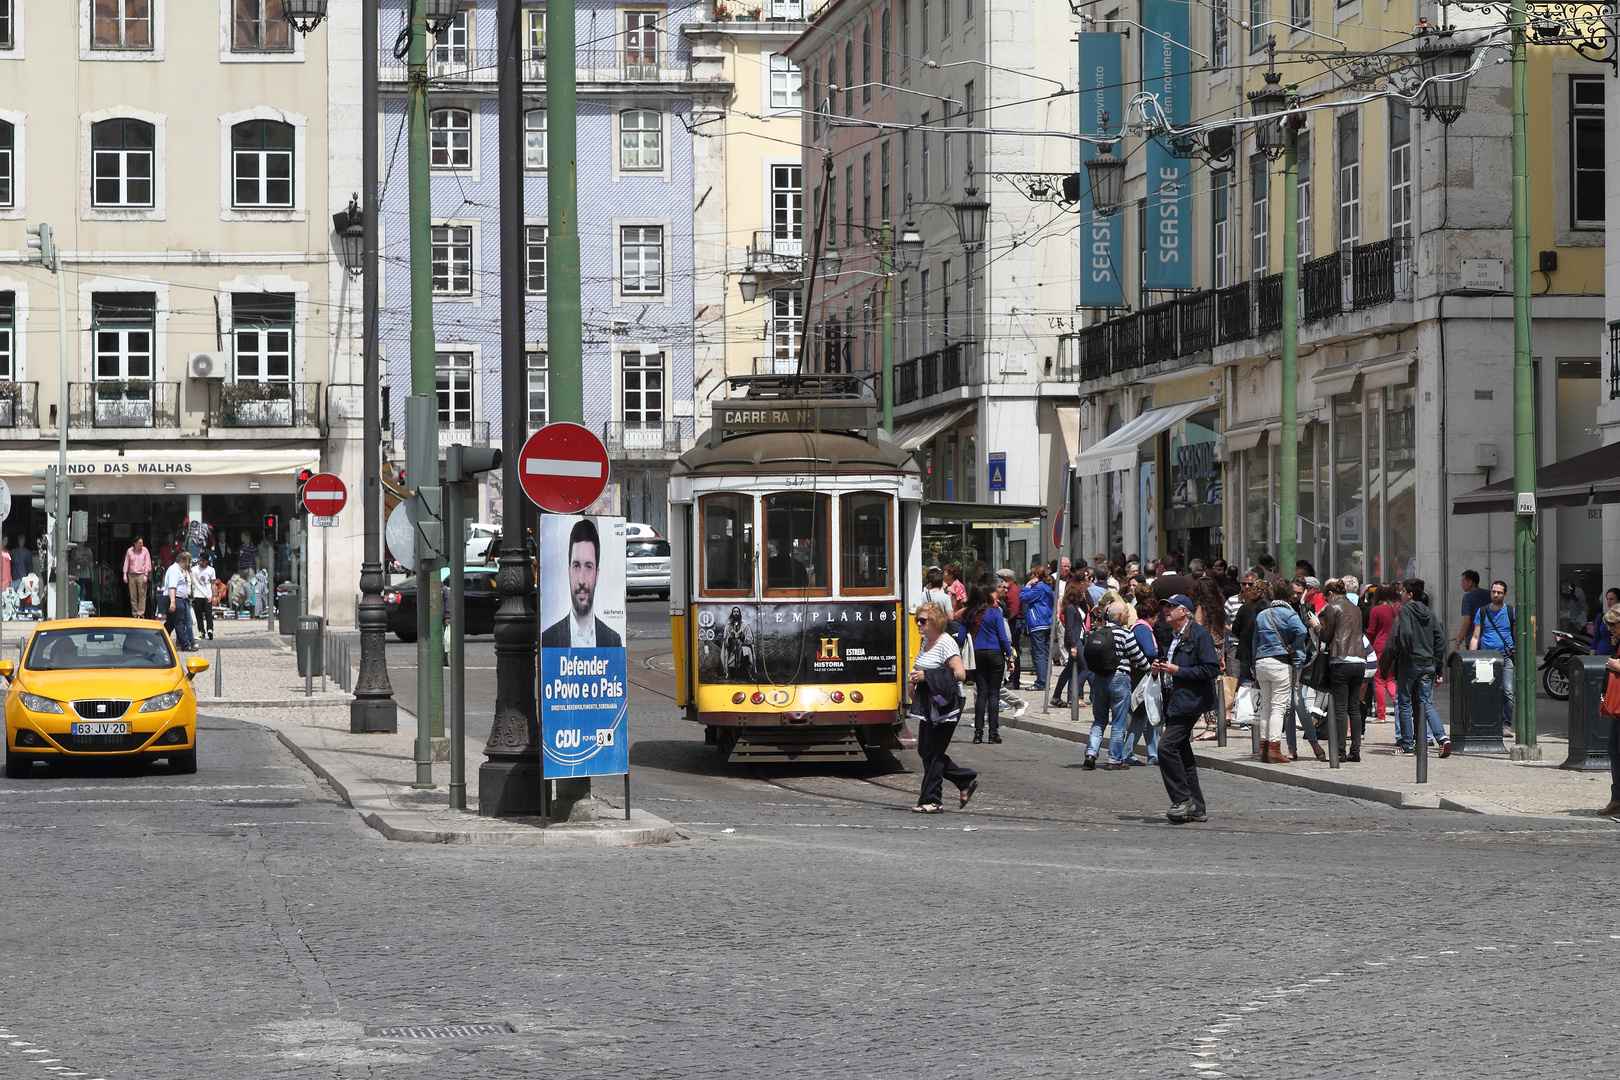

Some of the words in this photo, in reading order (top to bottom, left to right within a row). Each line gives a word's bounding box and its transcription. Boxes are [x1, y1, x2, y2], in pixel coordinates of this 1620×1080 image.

[1162, 31, 1172, 93] movimento
[1160, 167, 1179, 263] SEASIDE
[1092, 209, 1110, 282] SEASI
[725, 411, 790, 424] CARREIRA
[48, 464, 96, 473] MNDO
[104, 464, 129, 472] DAS
[138, 464, 192, 472] MALHAS
[1177, 441, 1217, 482] SEASIDE
[785, 477, 804, 486] 547
[1588, 509, 1602, 518] BET
[758, 609, 896, 623] TEMPLÁRIOS
[820, 637, 840, 658] H
[560, 655, 609, 676] Defender
[546, 684, 552, 700] o
[554, 679, 580, 699] Povo
[582, 682, 589, 698] e
[591, 682, 598, 698] o
[600, 676, 622, 698] País
[556, 729, 580, 748] CDU
